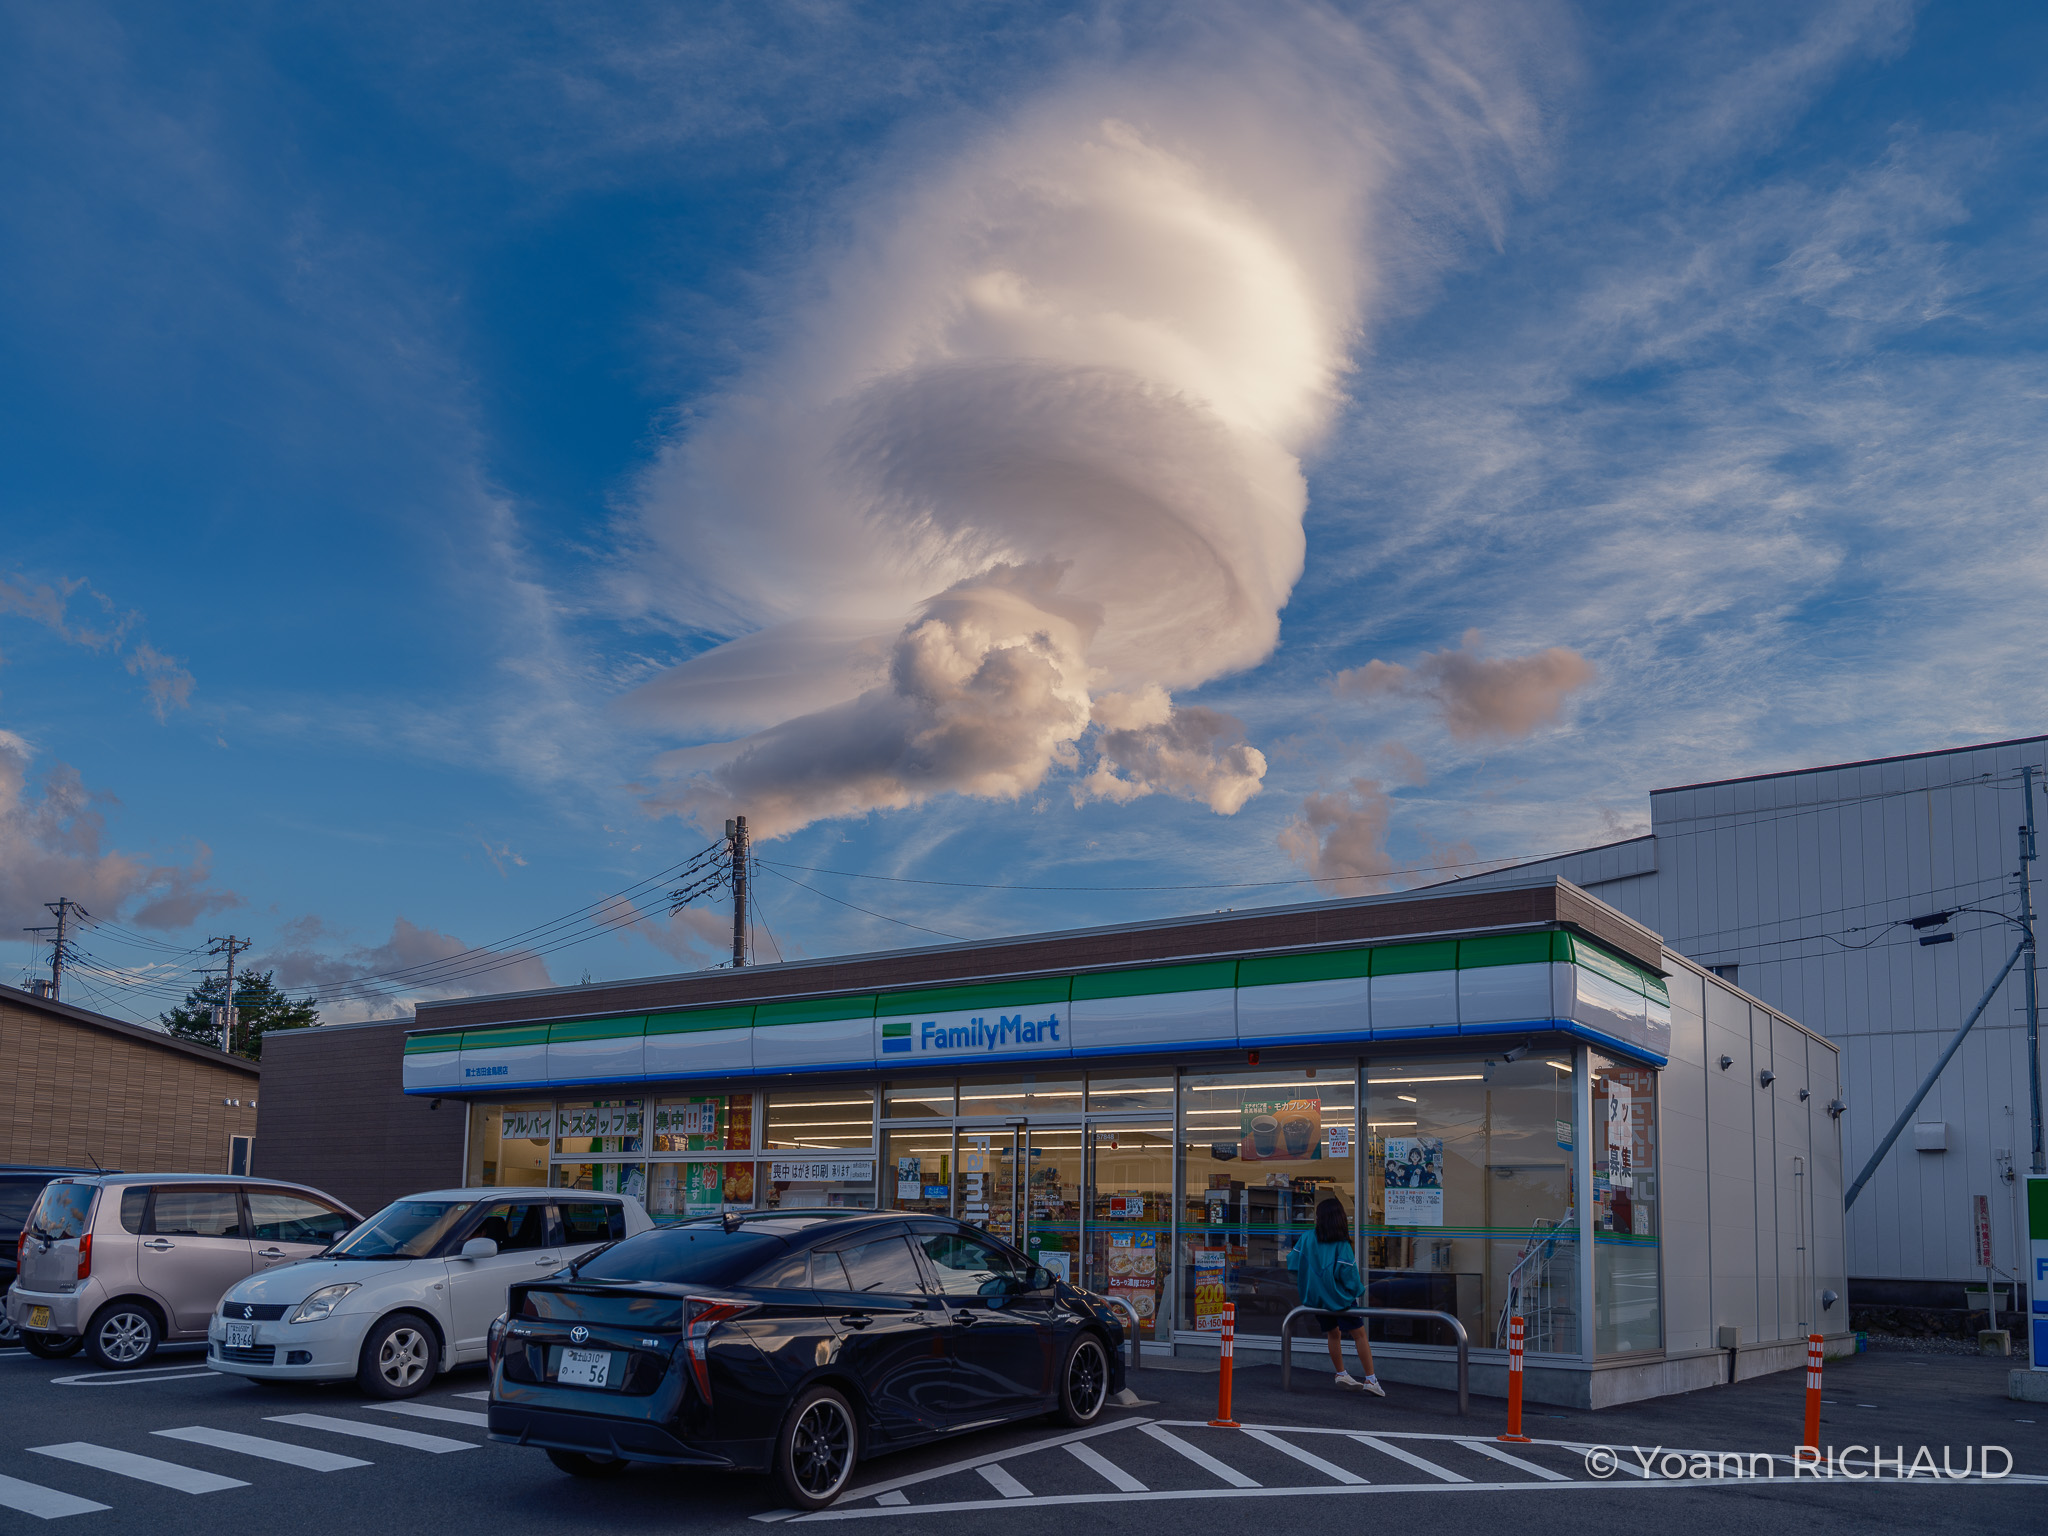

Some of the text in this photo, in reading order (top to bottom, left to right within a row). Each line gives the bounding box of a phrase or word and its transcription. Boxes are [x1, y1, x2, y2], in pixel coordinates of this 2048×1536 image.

[921, 1013, 1060, 1050] FamilyMart
[1274, 1100, 1317, 1111] モカブレンド
[773, 1164, 790, 1179] 喪中
[792, 1164, 810, 1179] はがき
[812, 1164, 828, 1179] 印刷
[232, 1333, 252, 1345] 83-66
